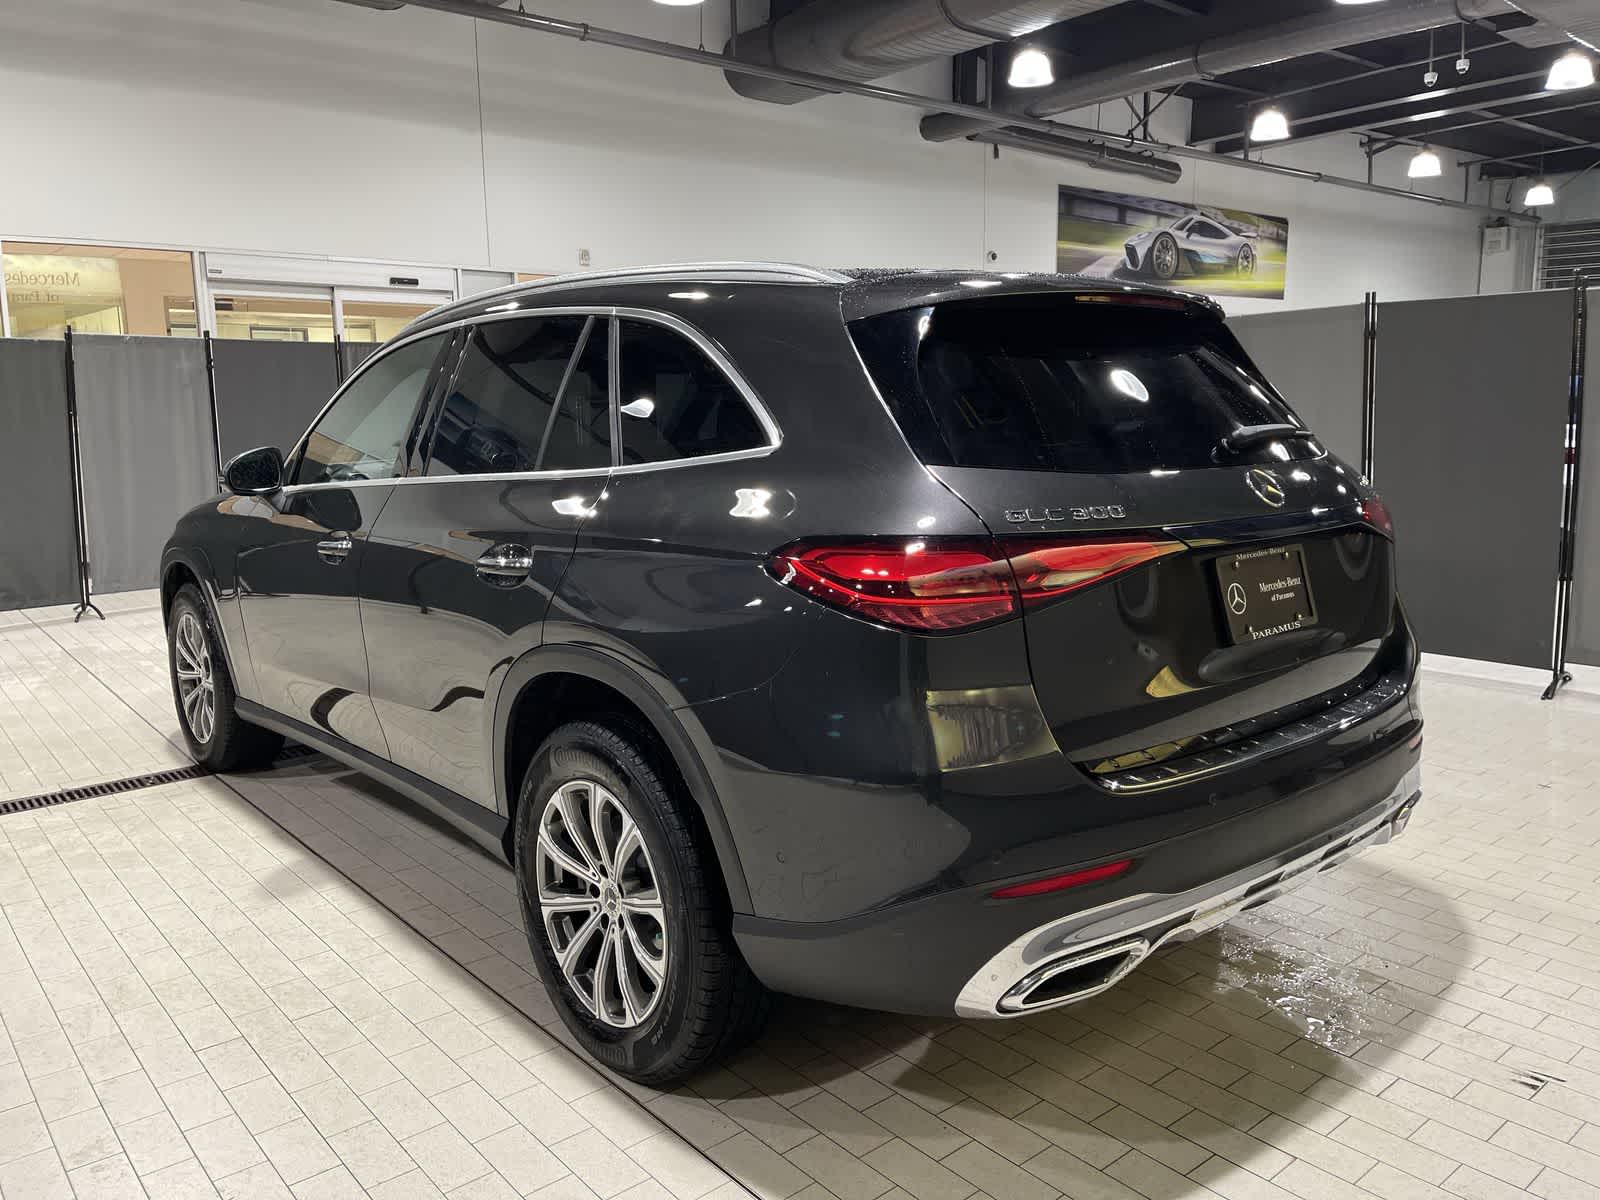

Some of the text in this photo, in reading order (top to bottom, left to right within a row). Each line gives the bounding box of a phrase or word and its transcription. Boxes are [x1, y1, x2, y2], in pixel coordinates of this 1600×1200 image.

[1004, 504, 1127, 523] GLC 300
[1259, 577, 1301, 592] Mercedes-Benz
[1252, 620, 1301, 639] PARAMUS
